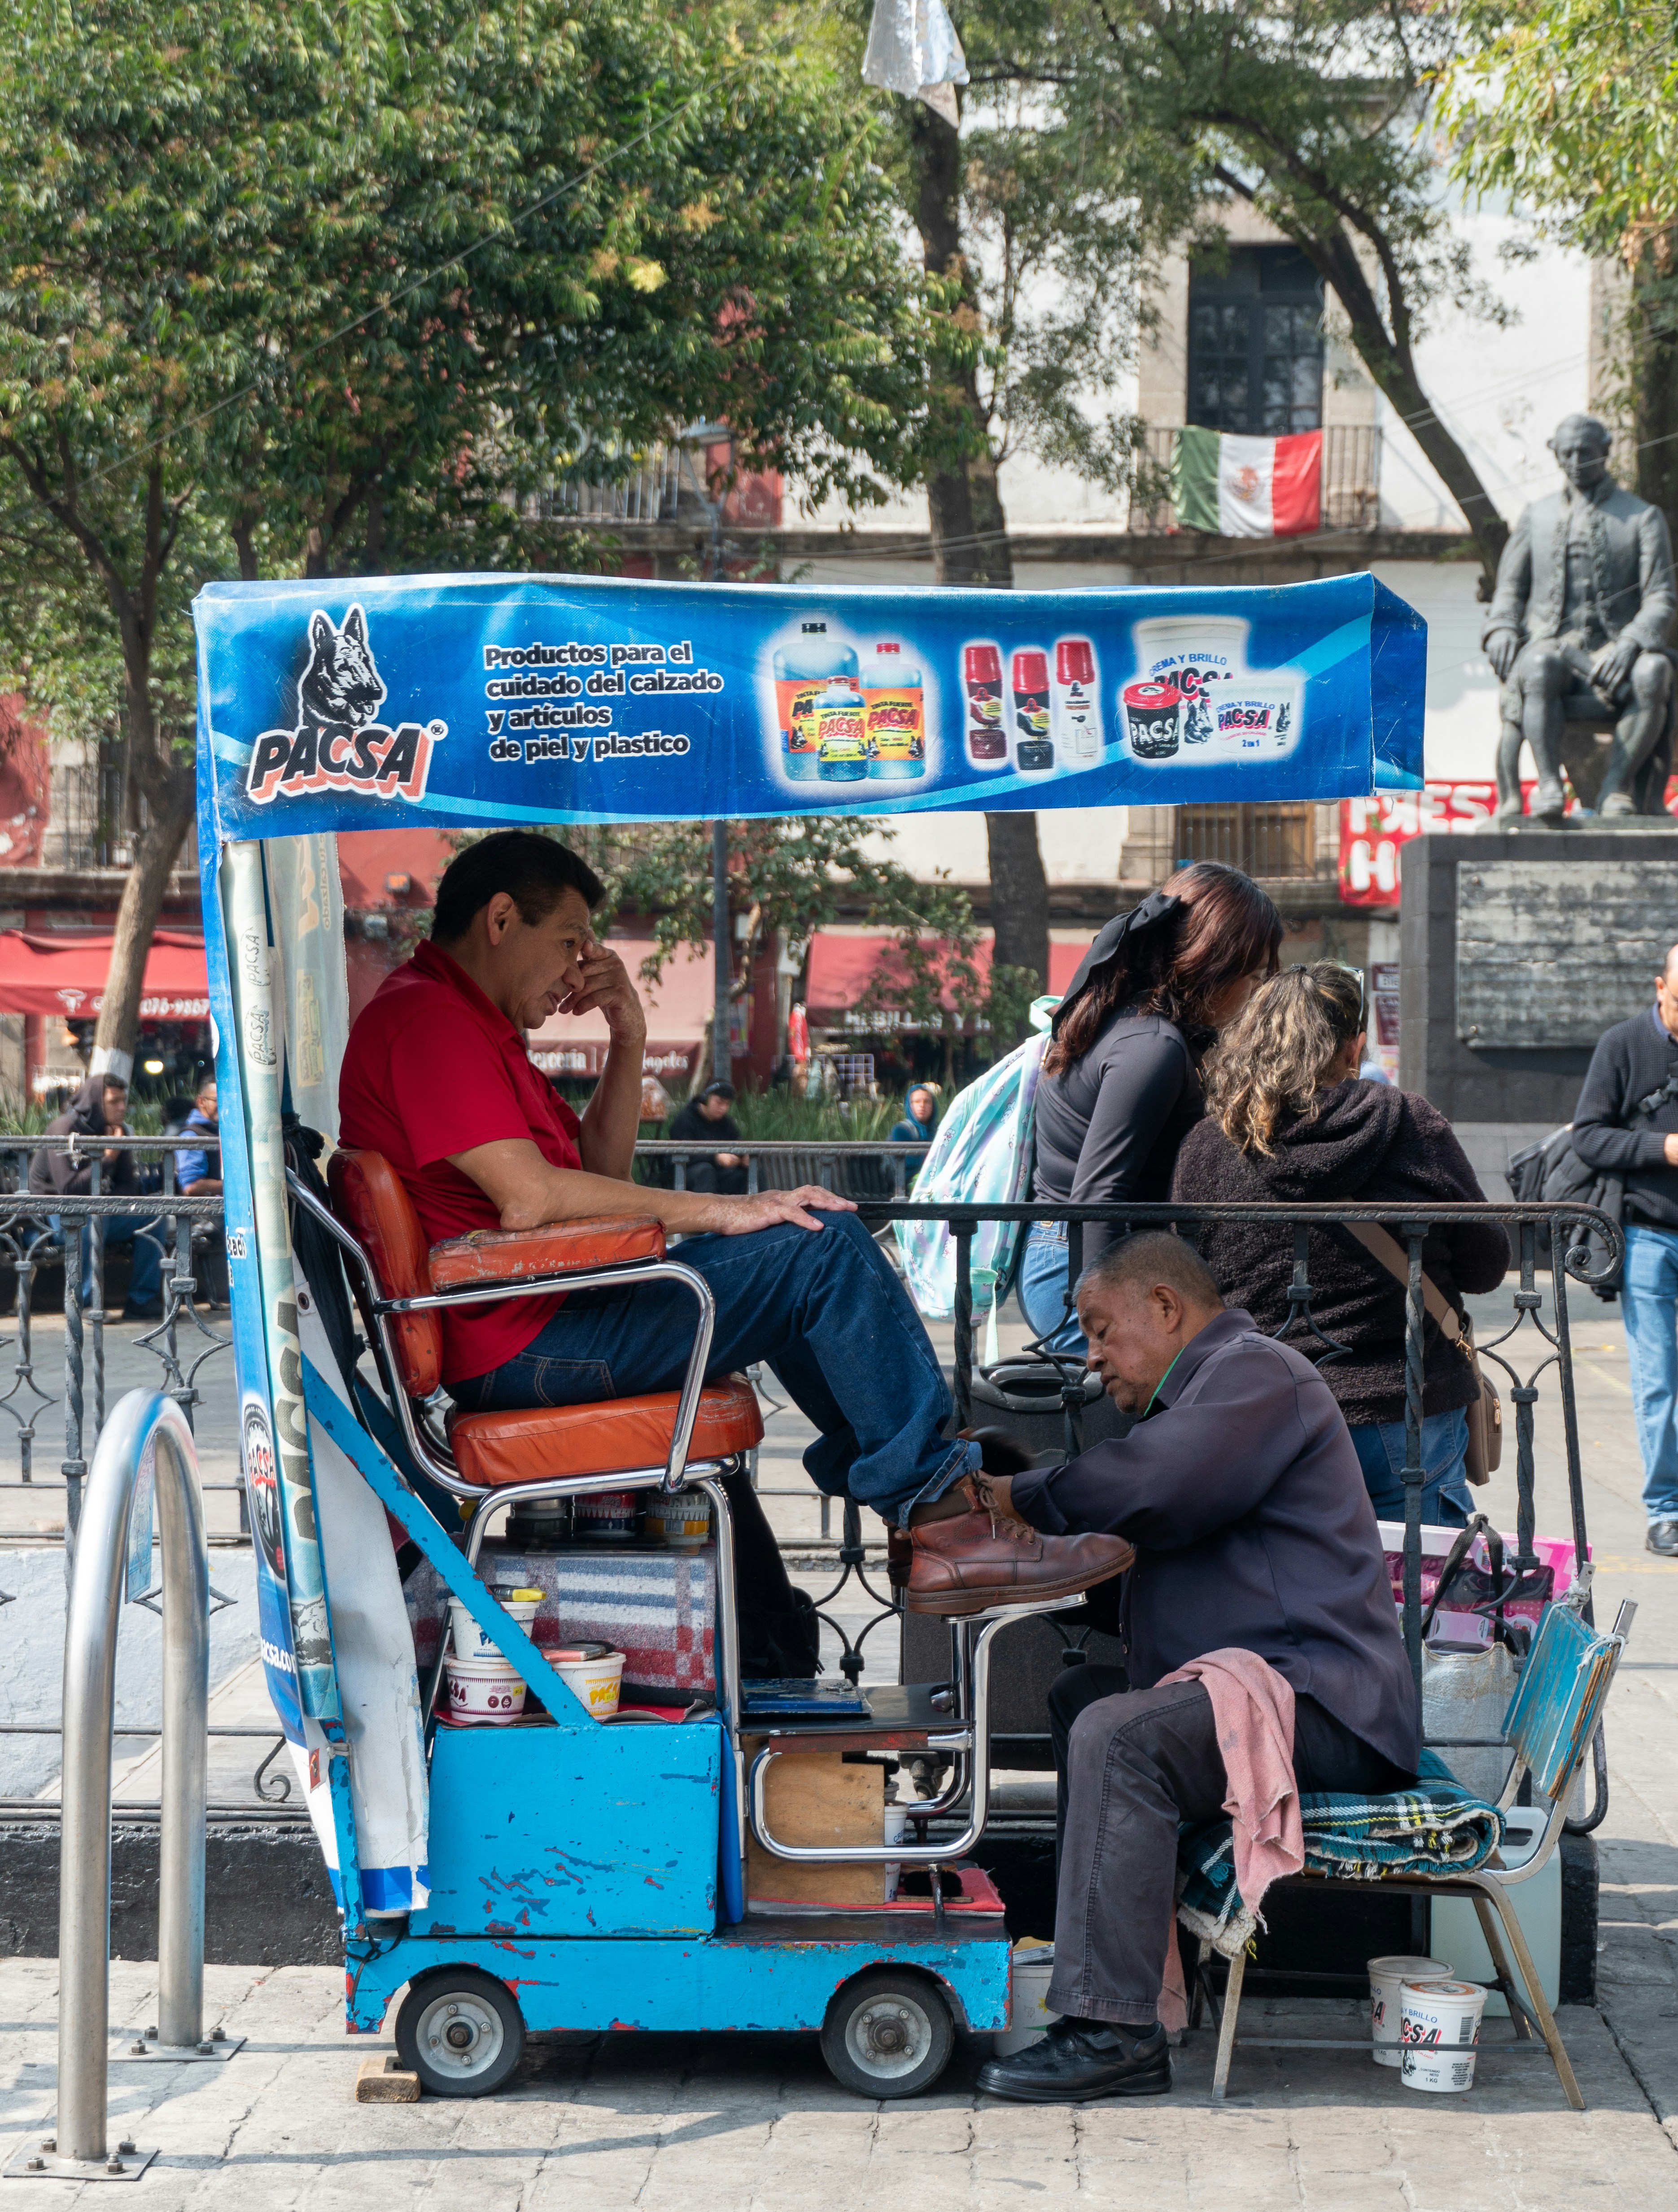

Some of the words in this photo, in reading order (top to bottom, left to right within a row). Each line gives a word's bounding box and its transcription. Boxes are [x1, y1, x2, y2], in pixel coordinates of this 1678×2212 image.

[485, 643, 606, 667] Productos
[611, 646, 665, 667] para
[669, 642, 692, 662] el
[1178, 654, 1185, 663] Y
[1189, 653, 1228, 666] BRILLO
[487, 674, 582, 698] cuidado
[587, 671, 626, 694] del
[630, 670, 723, 693] calzado
[487, 711, 505, 733] y
[509, 703, 612, 728] artículos
[818, 717, 865, 739] PACSA
[867, 707, 920, 730] PACSA
[1218, 708, 1271, 731] PACSA
[490, 737, 521, 759] de
[525, 734, 569, 762] piel
[573, 737, 590, 760] y
[594, 731, 690, 760] plastico
[249, 725, 431, 800] PACSA
[250, 1010, 268, 1062] PACSA
[642, 1049, 689, 1075] ngeles
[260, 1635, 297, 1674] acsa.co
[1409, 2008, 1438, 2024] BRILLO
[1401, 2016, 1442, 2049] CSA
